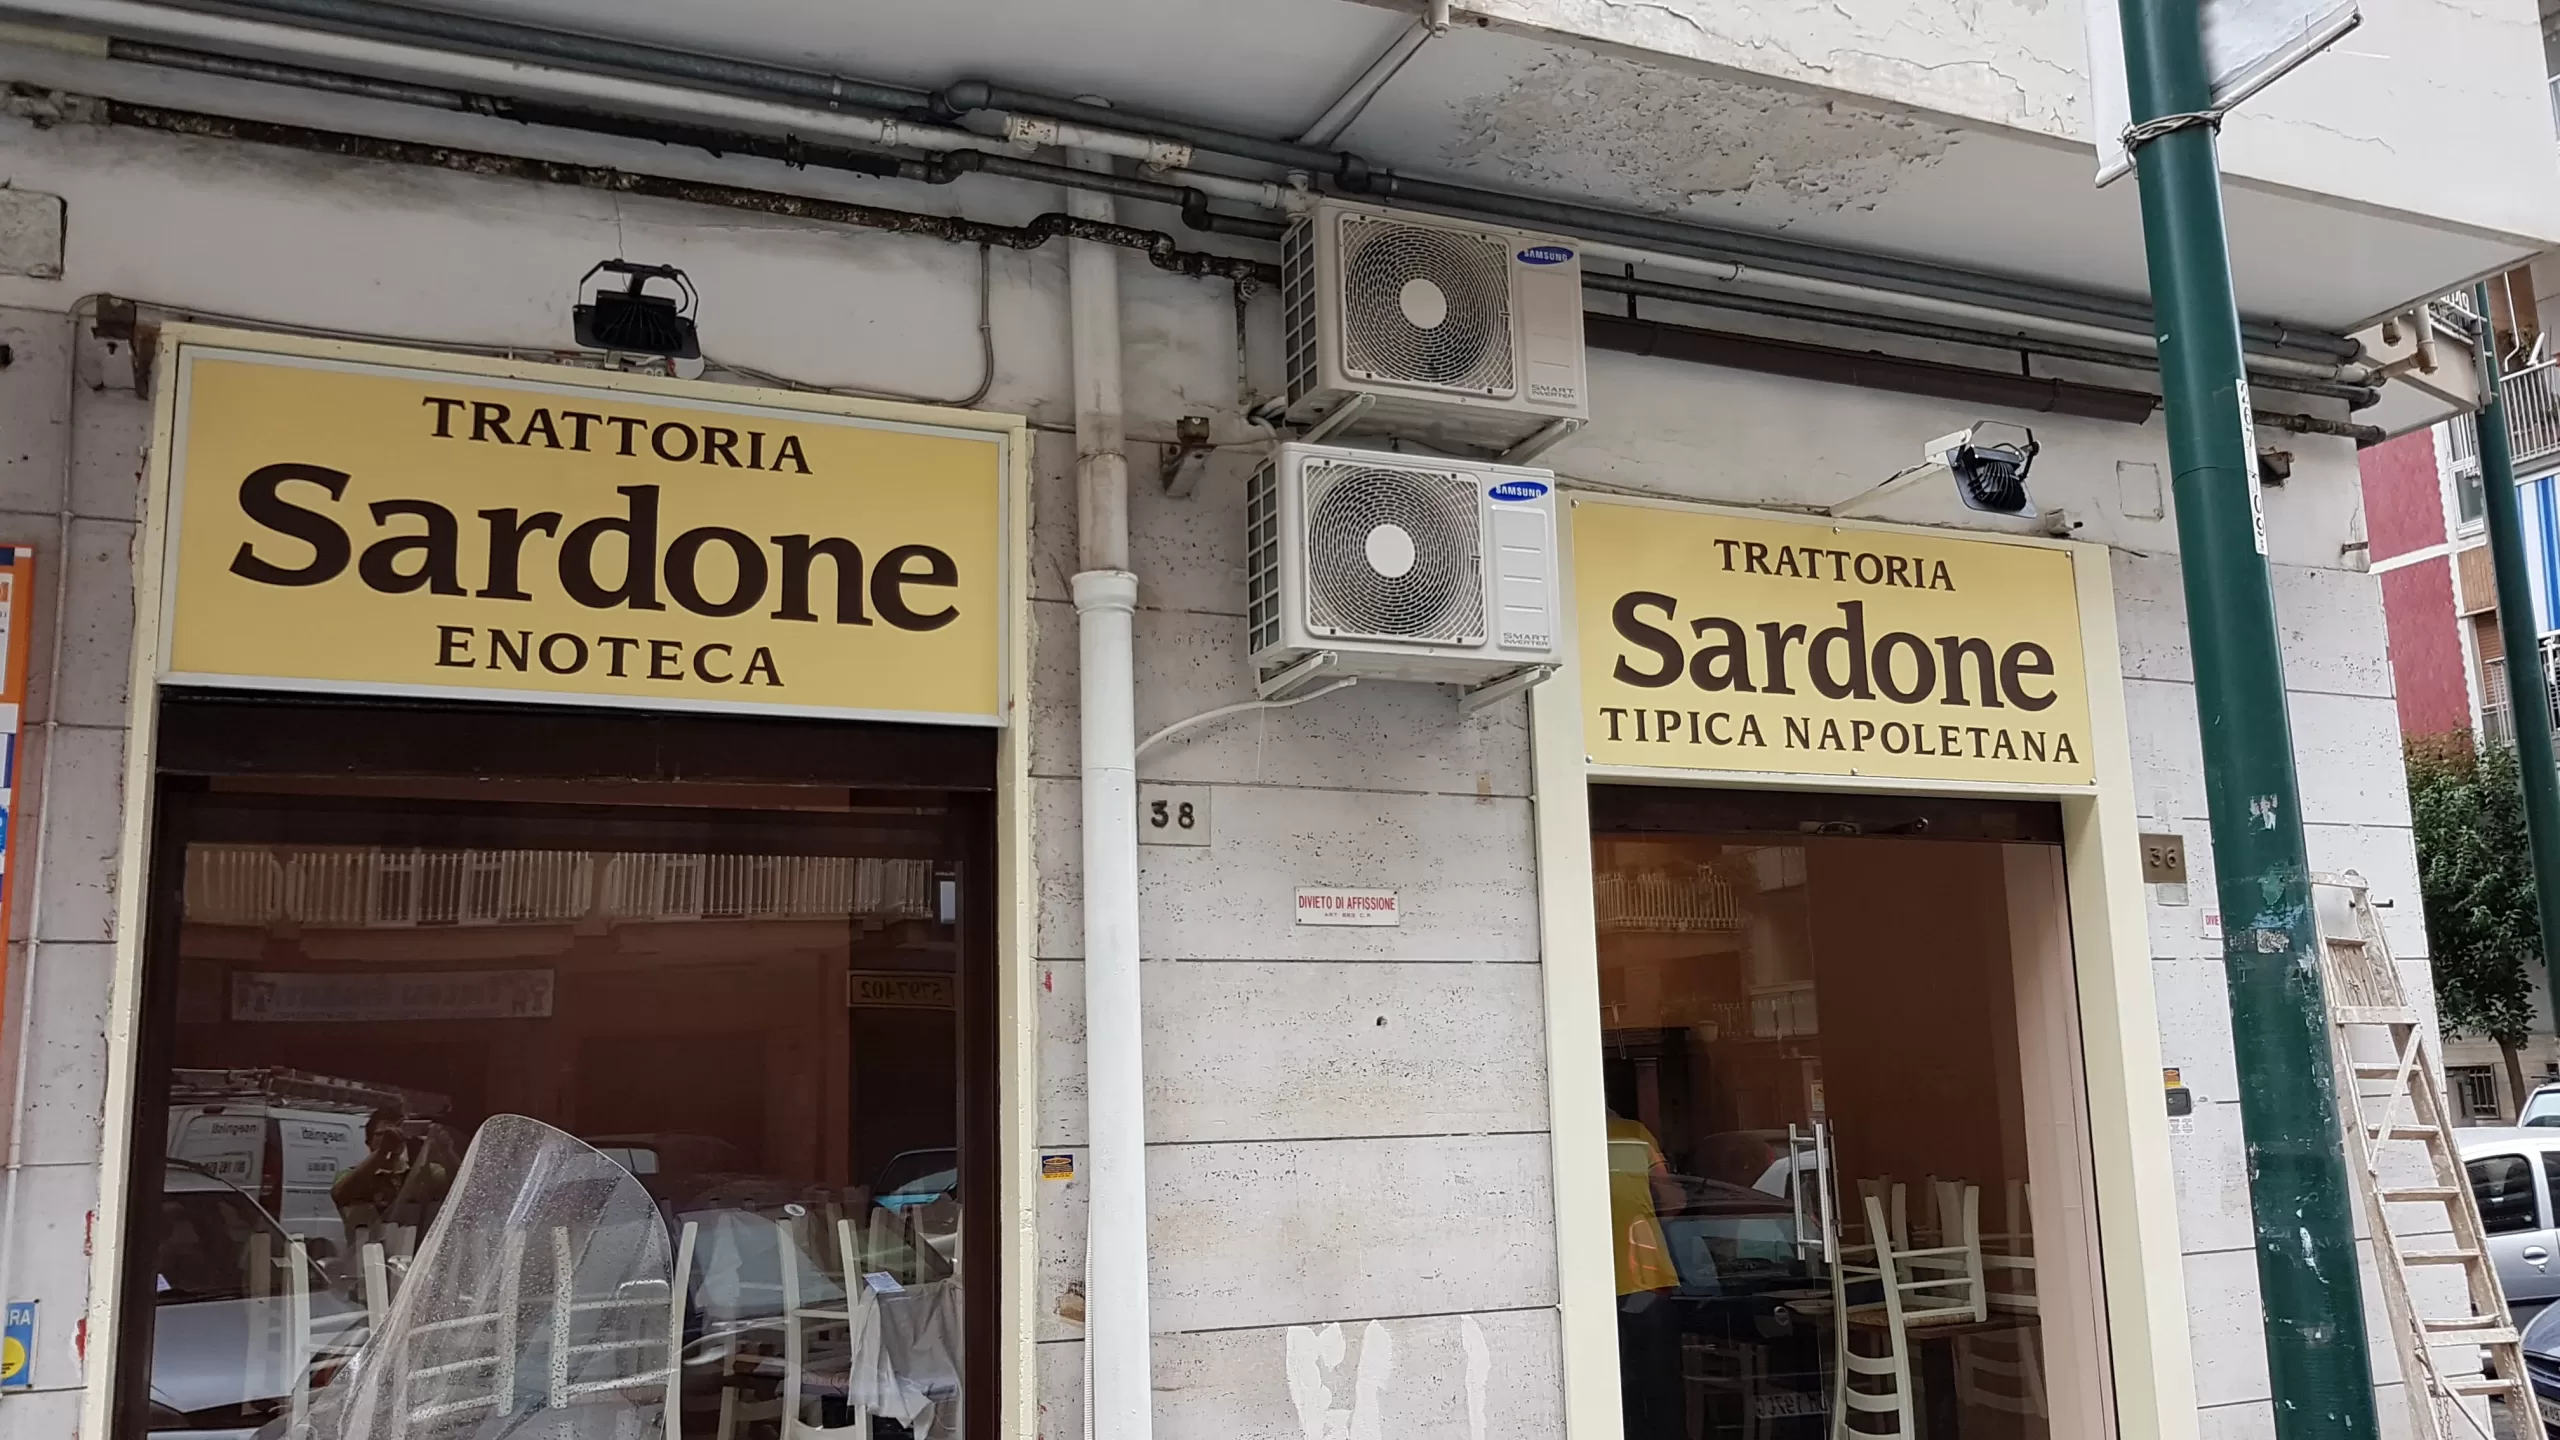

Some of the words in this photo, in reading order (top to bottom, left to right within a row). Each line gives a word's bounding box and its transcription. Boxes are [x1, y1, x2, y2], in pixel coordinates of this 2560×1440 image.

[1524, 249, 1567, 262] SAMSUNG
[1532, 384, 1575, 394] SMART
[1532, 390, 1574, 399] INVERTER
[422, 397, 812, 475] TRATTORIA
[1495, 484, 1542, 497] SAMSUNG
[229, 463, 960, 632] Sardone
[1714, 539, 1955, 592] TRATTORIA
[1503, 632, 1548, 641] SMART
[1504, 638, 1548, 646] INVERTER
[435, 625, 784, 687] ENOTECA
[1613, 592, 2057, 712] Sardone
[1600, 708, 1766, 747] TIPICA
[1784, 717, 2078, 764] NAPOLETANA
[1150, 799, 1195, 829] 38
[2149, 847, 2176, 869] 36
[1299, 895, 1332, 909] DIVIETO
[1336, 897, 1345, 910] DI
[1347, 897, 1396, 912] AFFISSIONE
[7, 1308, 31, 1326] RA
